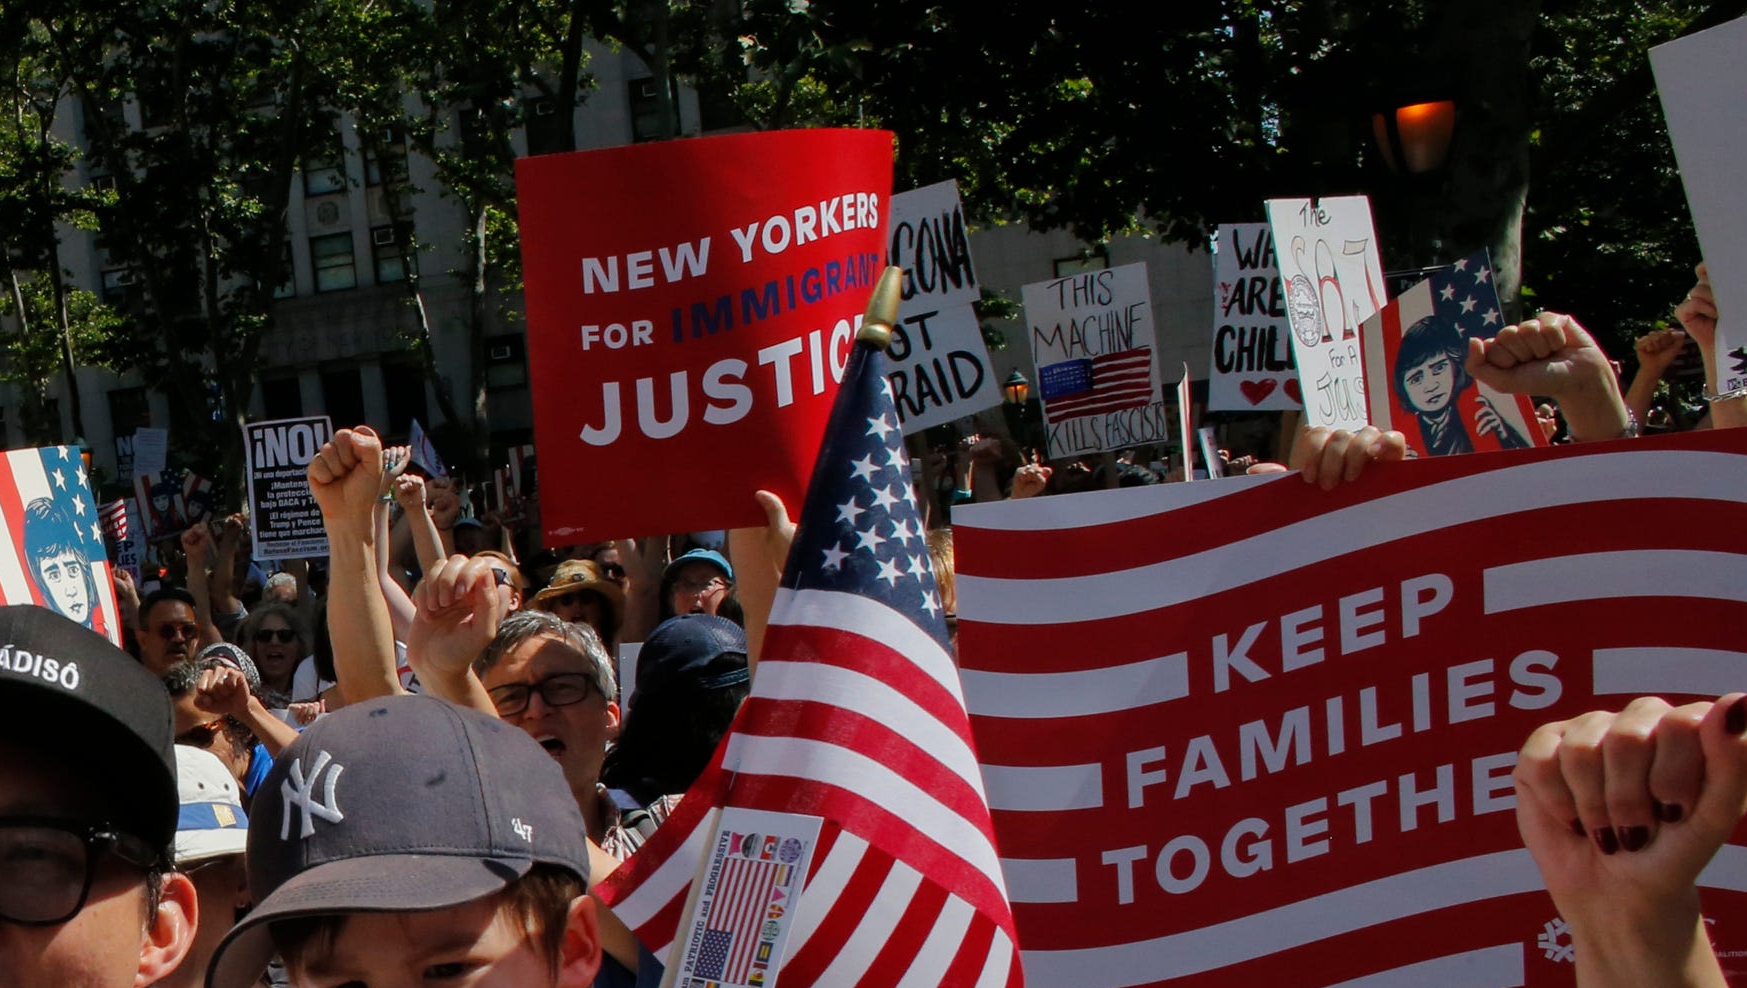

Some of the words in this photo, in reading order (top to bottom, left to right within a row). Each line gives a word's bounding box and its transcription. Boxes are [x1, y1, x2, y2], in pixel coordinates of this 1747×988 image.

[582, 237, 711, 294] NEW
[730, 193, 879, 263] YORKERS
[581, 320, 654, 350] FOR
[672, 254, 879, 343] IMMIGRANT
[1047, 271, 1114, 310] THIS
[885, 311, 938, 361] OT
[1034, 302, 1150, 363] MACHINE
[580, 314, 864, 446] JUSTIC
[888, 351, 984, 423] RAID
[1046, 417, 1102, 454] KILLS
[1212, 573, 1454, 693] KEEP
[1126, 649, 1563, 809] FAMILIES
[704, 829, 731, 897] PROGRESSIVE
[1102, 751, 1520, 905] TOGETHE
[702, 900, 711, 918] and
[684, 920, 705, 973] PATRIOTIC
